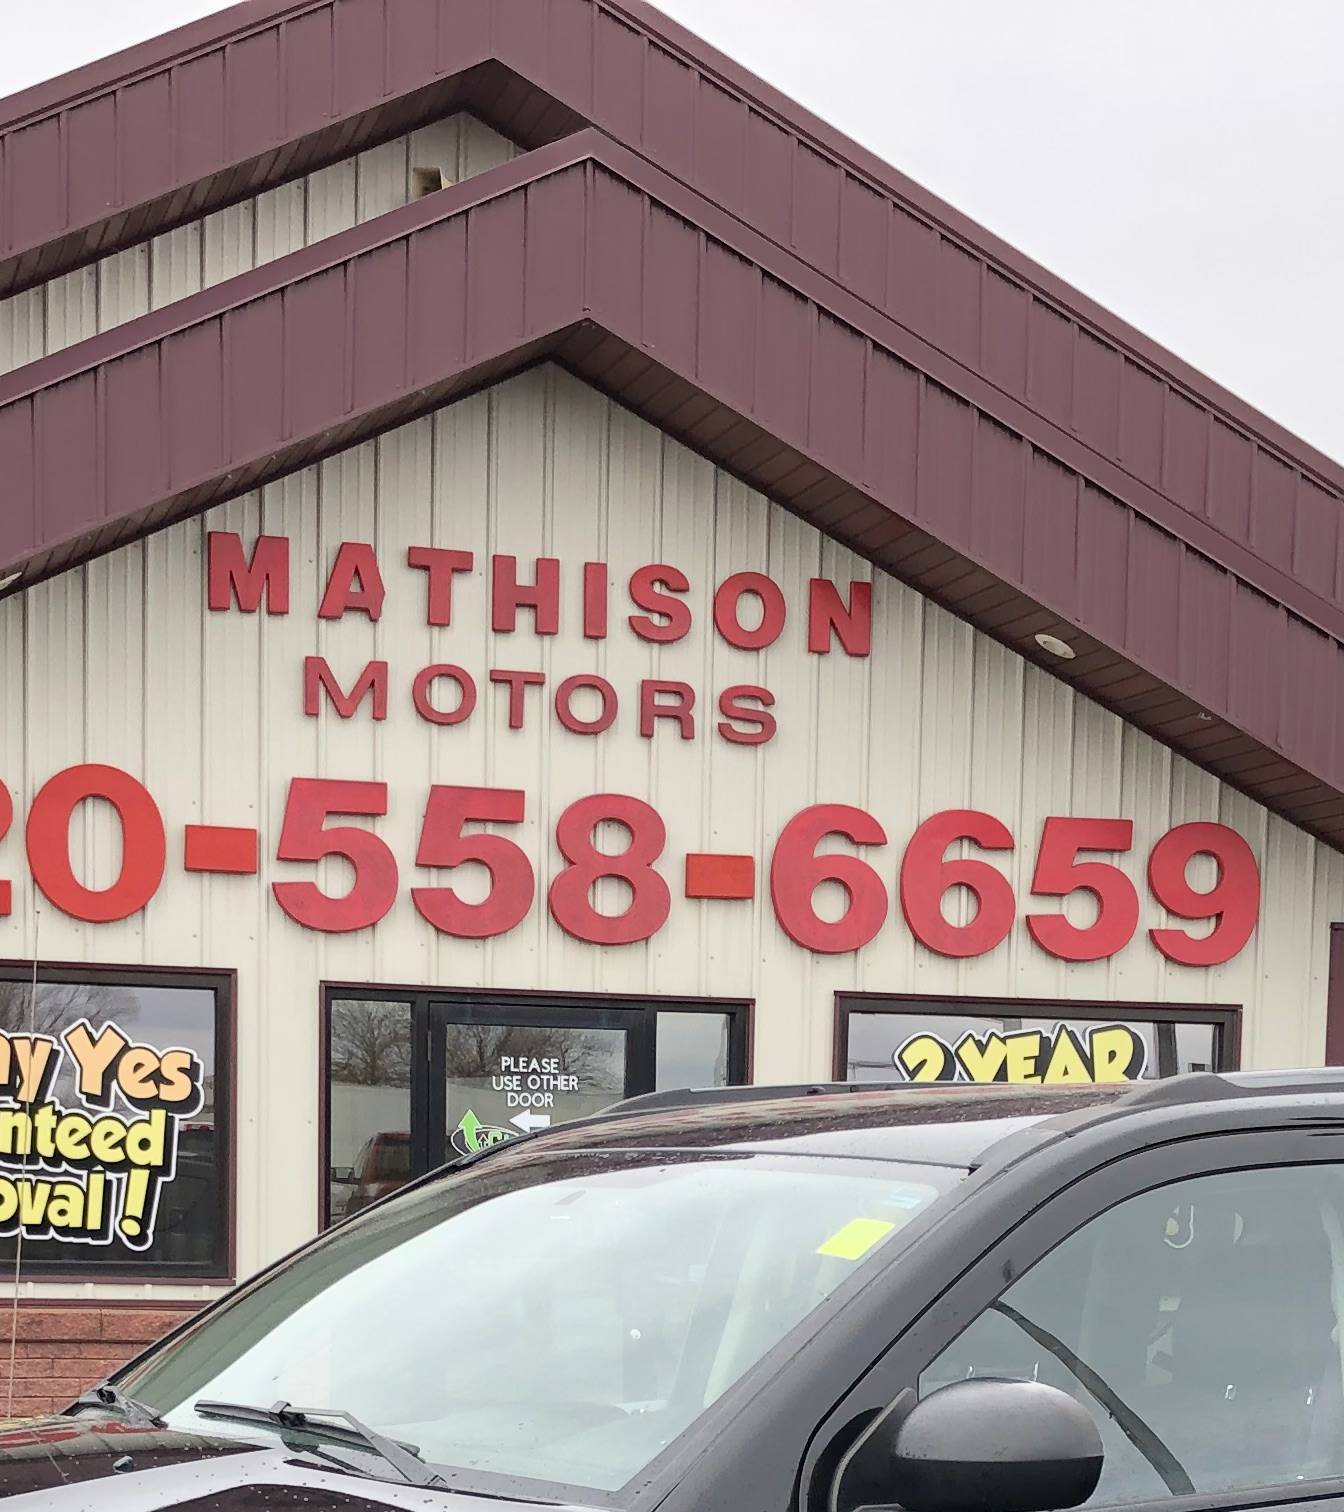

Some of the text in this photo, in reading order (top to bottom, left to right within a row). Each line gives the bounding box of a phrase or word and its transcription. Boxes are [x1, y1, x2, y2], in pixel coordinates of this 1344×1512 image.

[207, 530, 873, 659] MATHISON
[303, 656, 778, 746] MOTORS
[63, 1021, 199, 1104] Yes
[492, 1074, 579, 1091] USE OTHER
[501, 1056, 560, 1074] PLEASE
[899, 1024, 1136, 1084] 2 YEAR
[507, 1092, 554, 1107] DOOR
